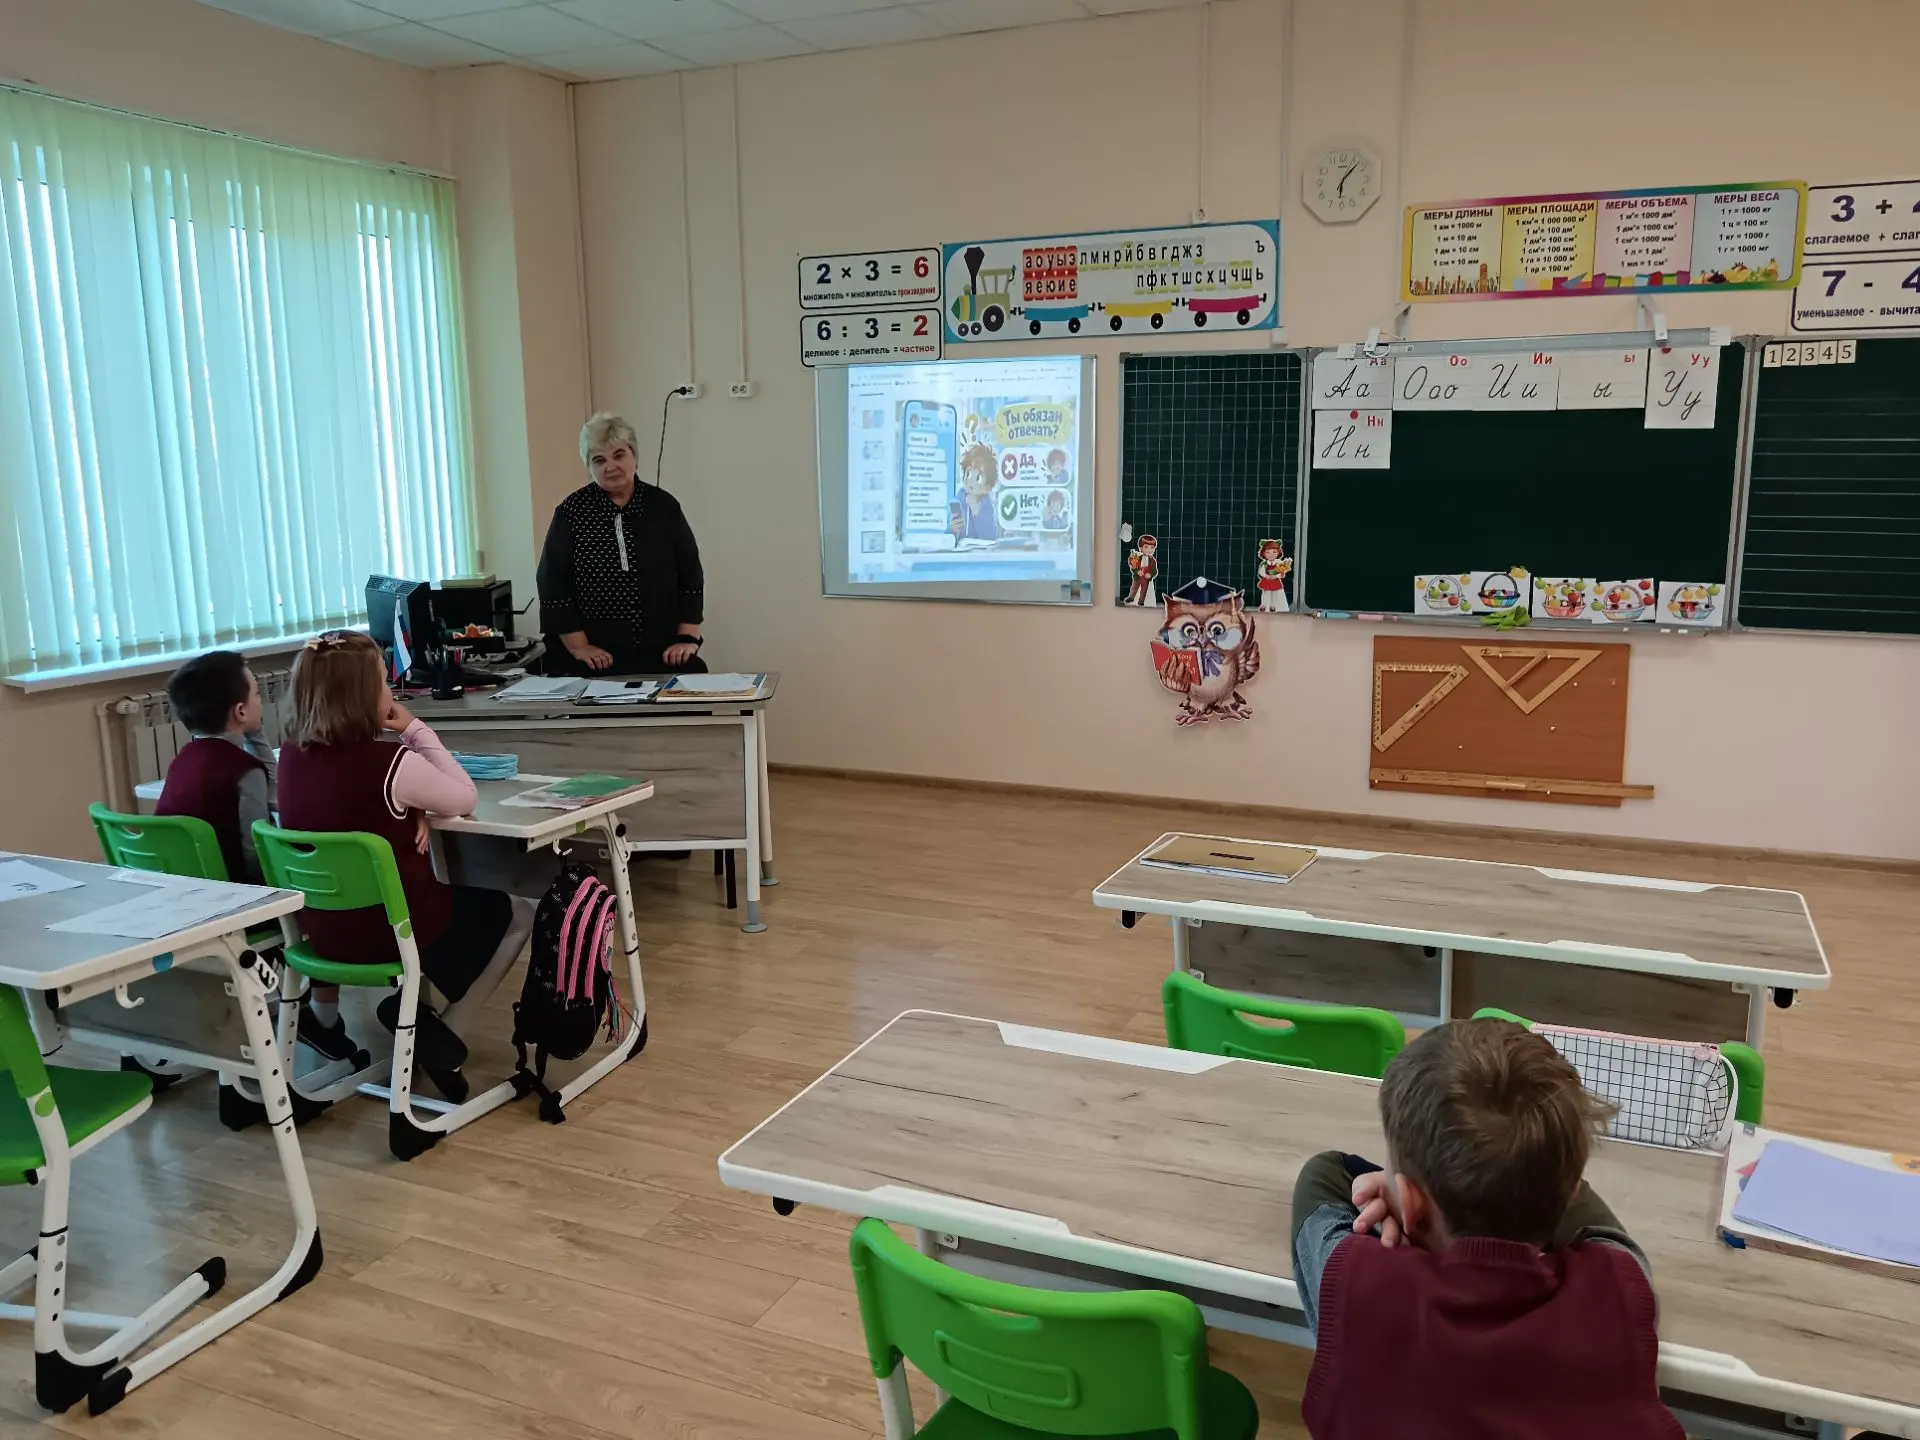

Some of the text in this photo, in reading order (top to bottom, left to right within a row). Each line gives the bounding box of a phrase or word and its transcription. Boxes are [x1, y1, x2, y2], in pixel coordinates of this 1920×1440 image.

[1605, 197, 1687, 210] МЕРЫ ОБЪЕМА
[1714, 192, 1779, 203] МЕРЫ ВЕСА
[1424, 209, 1492, 220] МЕРЫ ДЛИНЫ
[1508, 203, 1594, 215] МЕРЫ ПЛОЩАДИ
[1830, 195, 1855, 222] 3
[1805, 233, 1870, 245] слагаемое
[816, 263, 831, 284] 2
[865, 260, 880, 281] 3
[913, 256, 929, 278] 6
[1822, 270, 1846, 297] 7
[804, 292, 844, 301] множитель
[1797, 307, 1864, 320] уменьшаемое
[817, 320, 831, 340] 6
[865, 318, 879, 339] 3
[913, 315, 928, 336] 2
[804, 349, 839, 358] делимое
[849, 346, 890, 357] делитель
[900, 344, 934, 353] частное
[1769, 345, 1852, 363] 1 2 3 4 5
[1450, 356, 1468, 366] Оо
[1533, 352, 1552, 365] Ии
[1691, 354, 1710, 368] Уу
[1003, 408, 1063, 426] Ты обязан
[1367, 416, 1384, 426] Нн
[1008, 424, 1059, 440] отвечать?
[1020, 453, 1037, 468] Да,
[1020, 494, 1040, 508] Нет,
